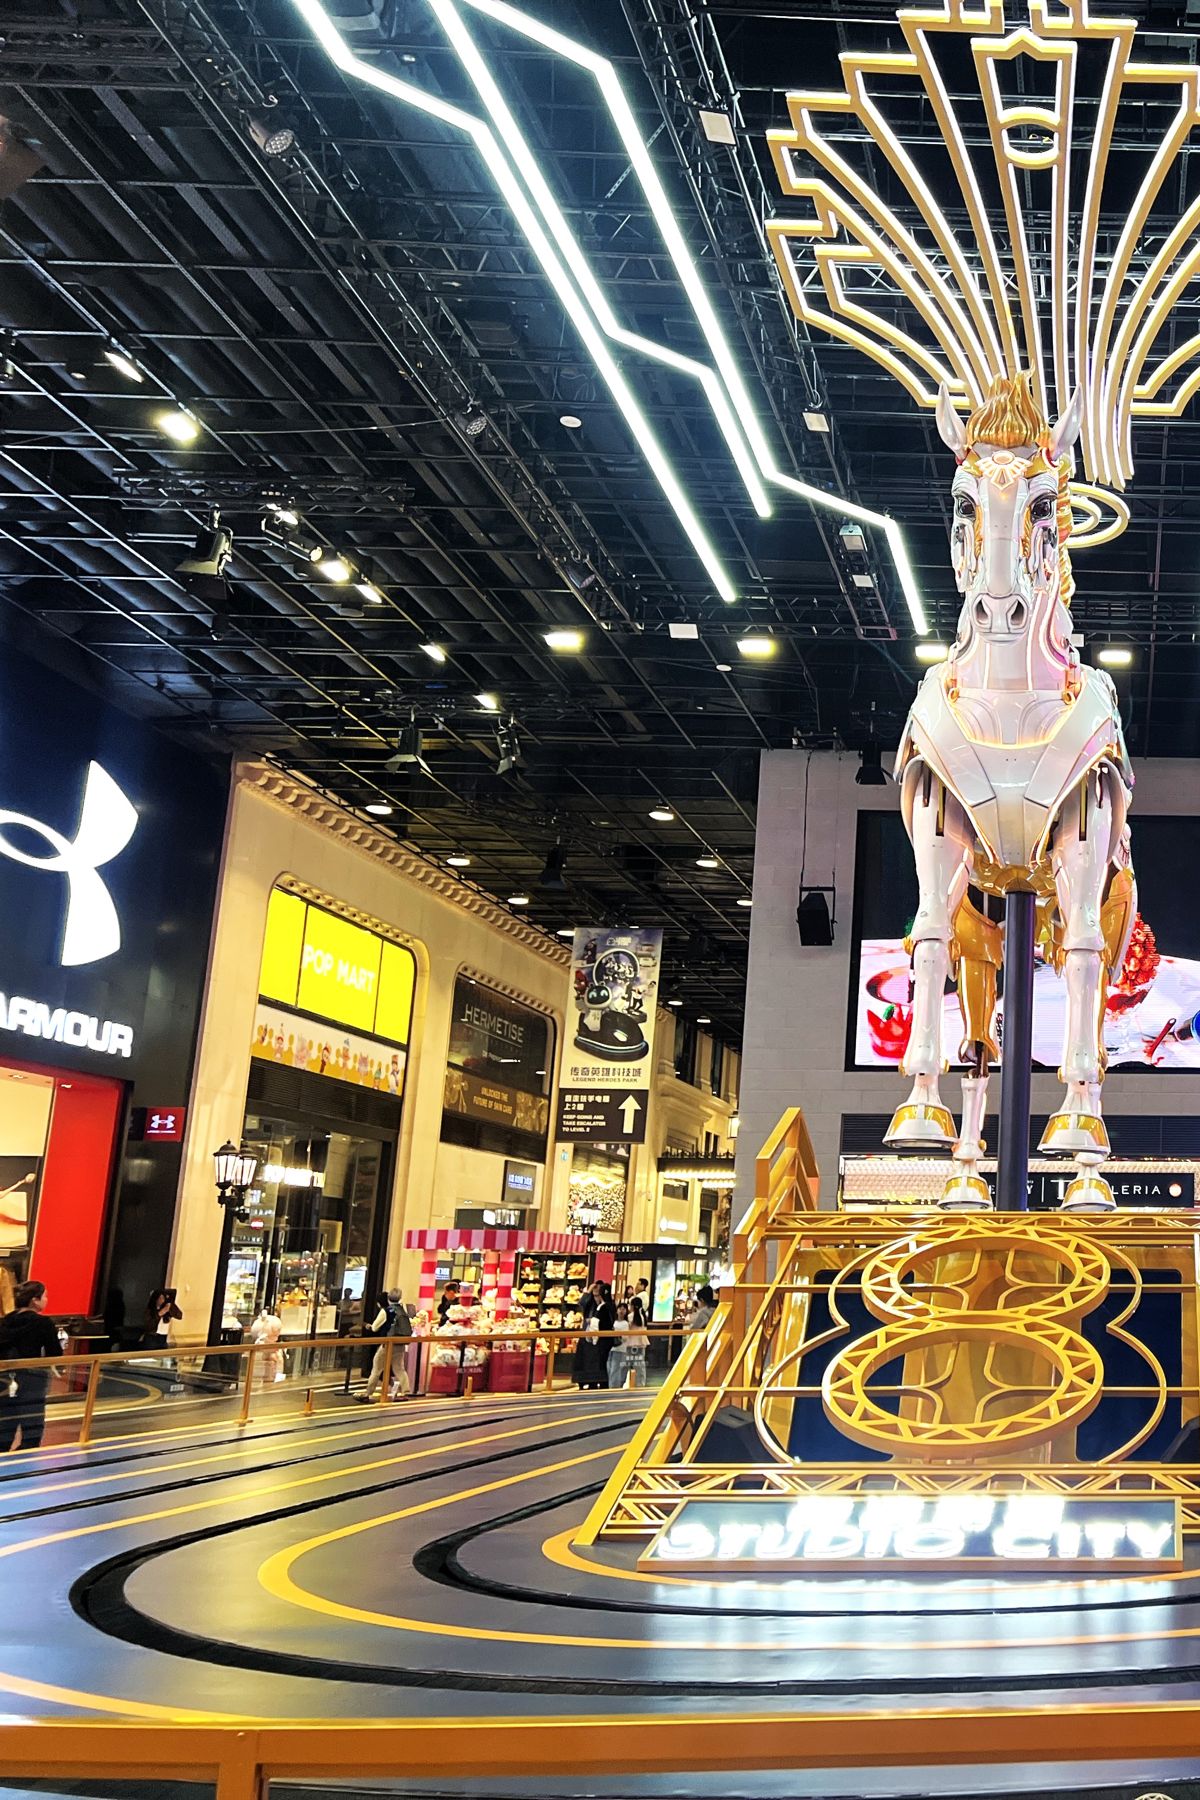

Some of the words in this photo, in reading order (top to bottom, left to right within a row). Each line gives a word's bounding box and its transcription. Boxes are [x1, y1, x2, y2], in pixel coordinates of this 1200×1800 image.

[303, 944, 334, 976] POP
[336, 960, 375, 994] MART
[464, 1003, 524, 1044] HERMETISE
[656, 1522, 965, 1559] STUDIO
[992, 1522, 1174, 1559] CITY
